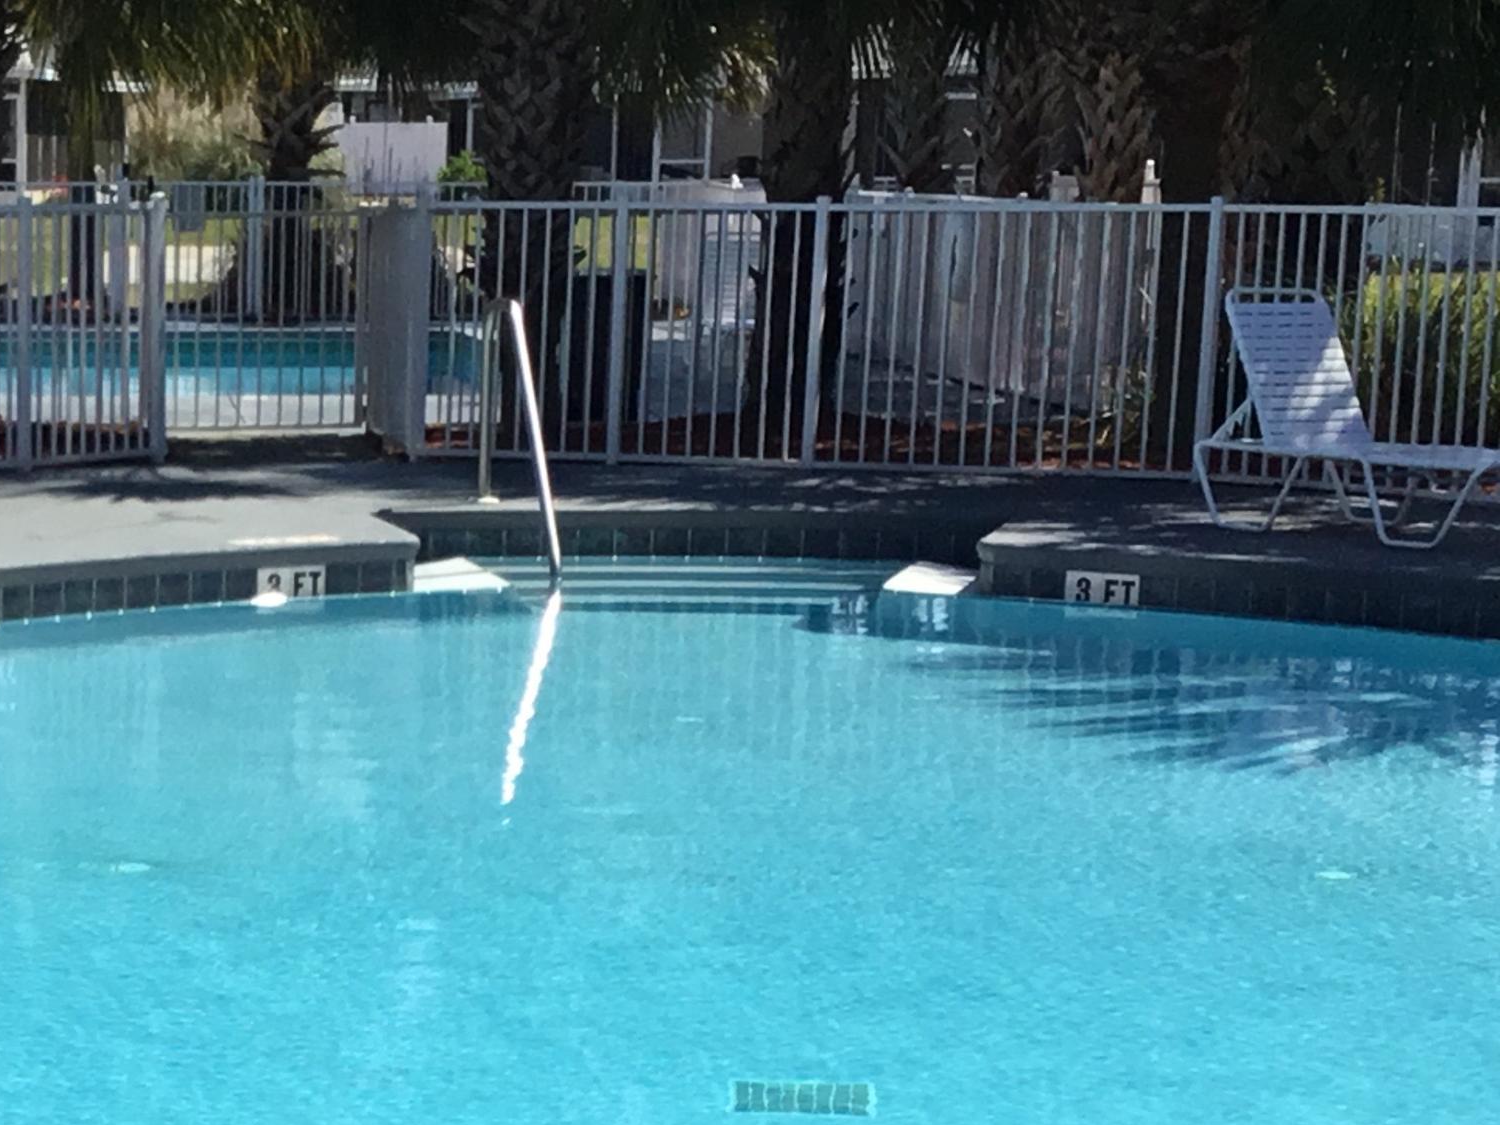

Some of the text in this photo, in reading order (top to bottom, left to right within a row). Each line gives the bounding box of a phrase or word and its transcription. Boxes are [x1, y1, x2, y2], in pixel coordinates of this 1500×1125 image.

[293, 571, 321, 597] FT
[1075, 577, 1136, 605] 3 FT
